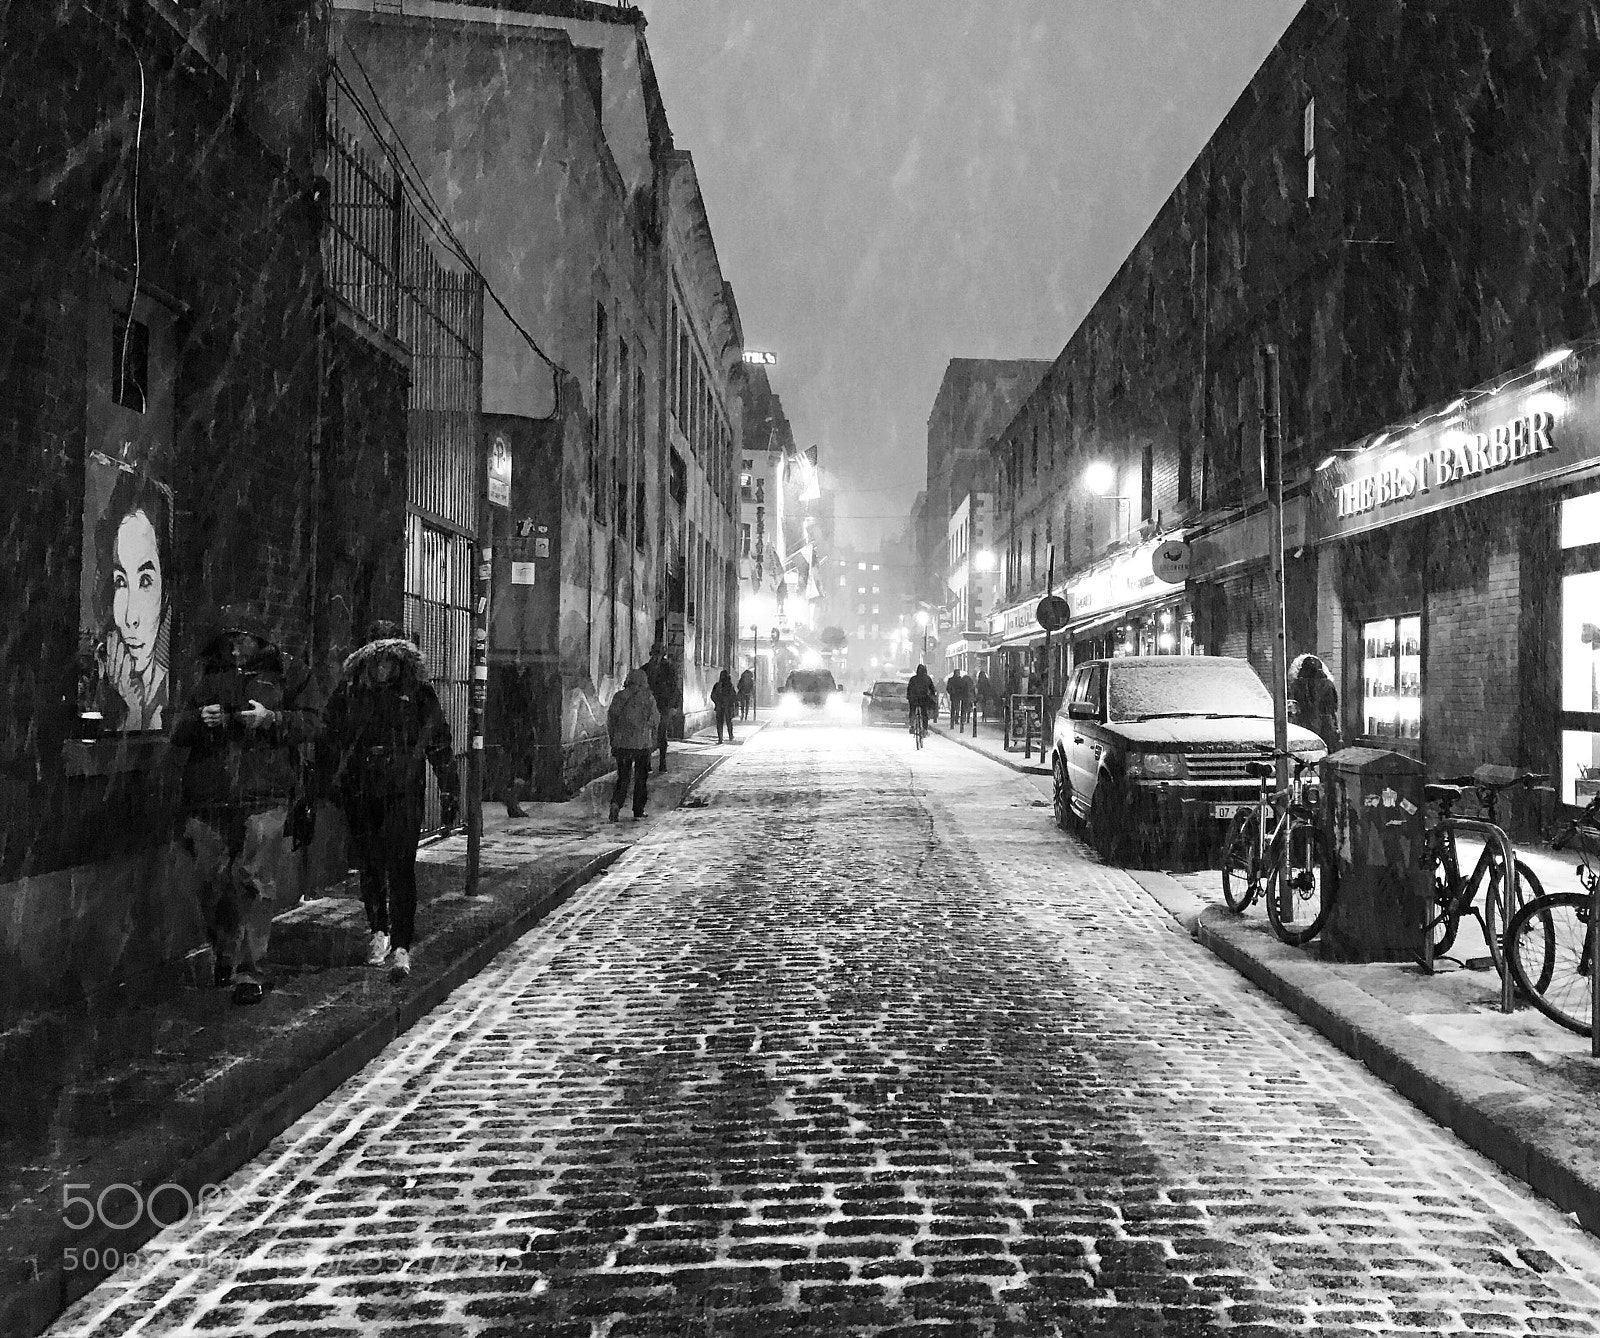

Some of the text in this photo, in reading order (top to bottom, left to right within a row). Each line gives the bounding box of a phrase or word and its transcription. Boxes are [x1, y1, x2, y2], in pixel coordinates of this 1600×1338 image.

[1335, 411, 1554, 518] THE BEST BARBER
